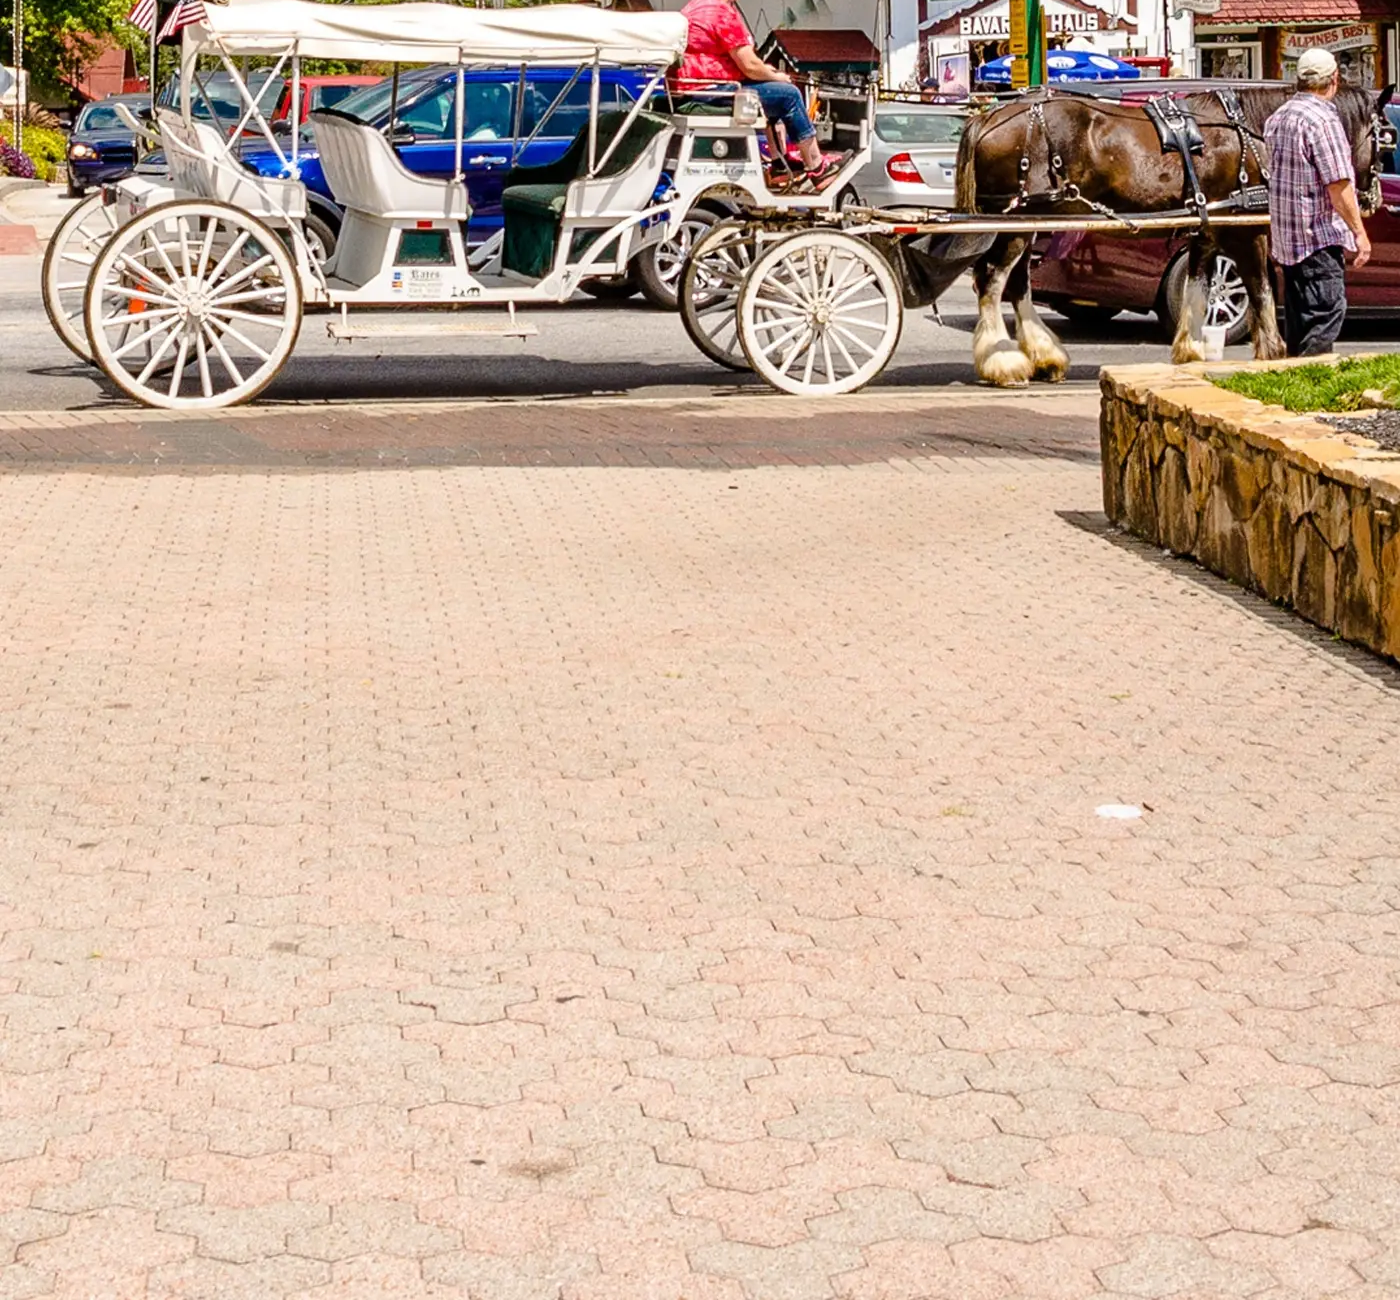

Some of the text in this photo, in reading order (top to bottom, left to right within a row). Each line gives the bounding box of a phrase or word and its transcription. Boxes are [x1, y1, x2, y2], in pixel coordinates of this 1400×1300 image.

[1051, 13, 1098, 32] HAUS
[1287, 24, 1370, 48] ALPINES BEST
